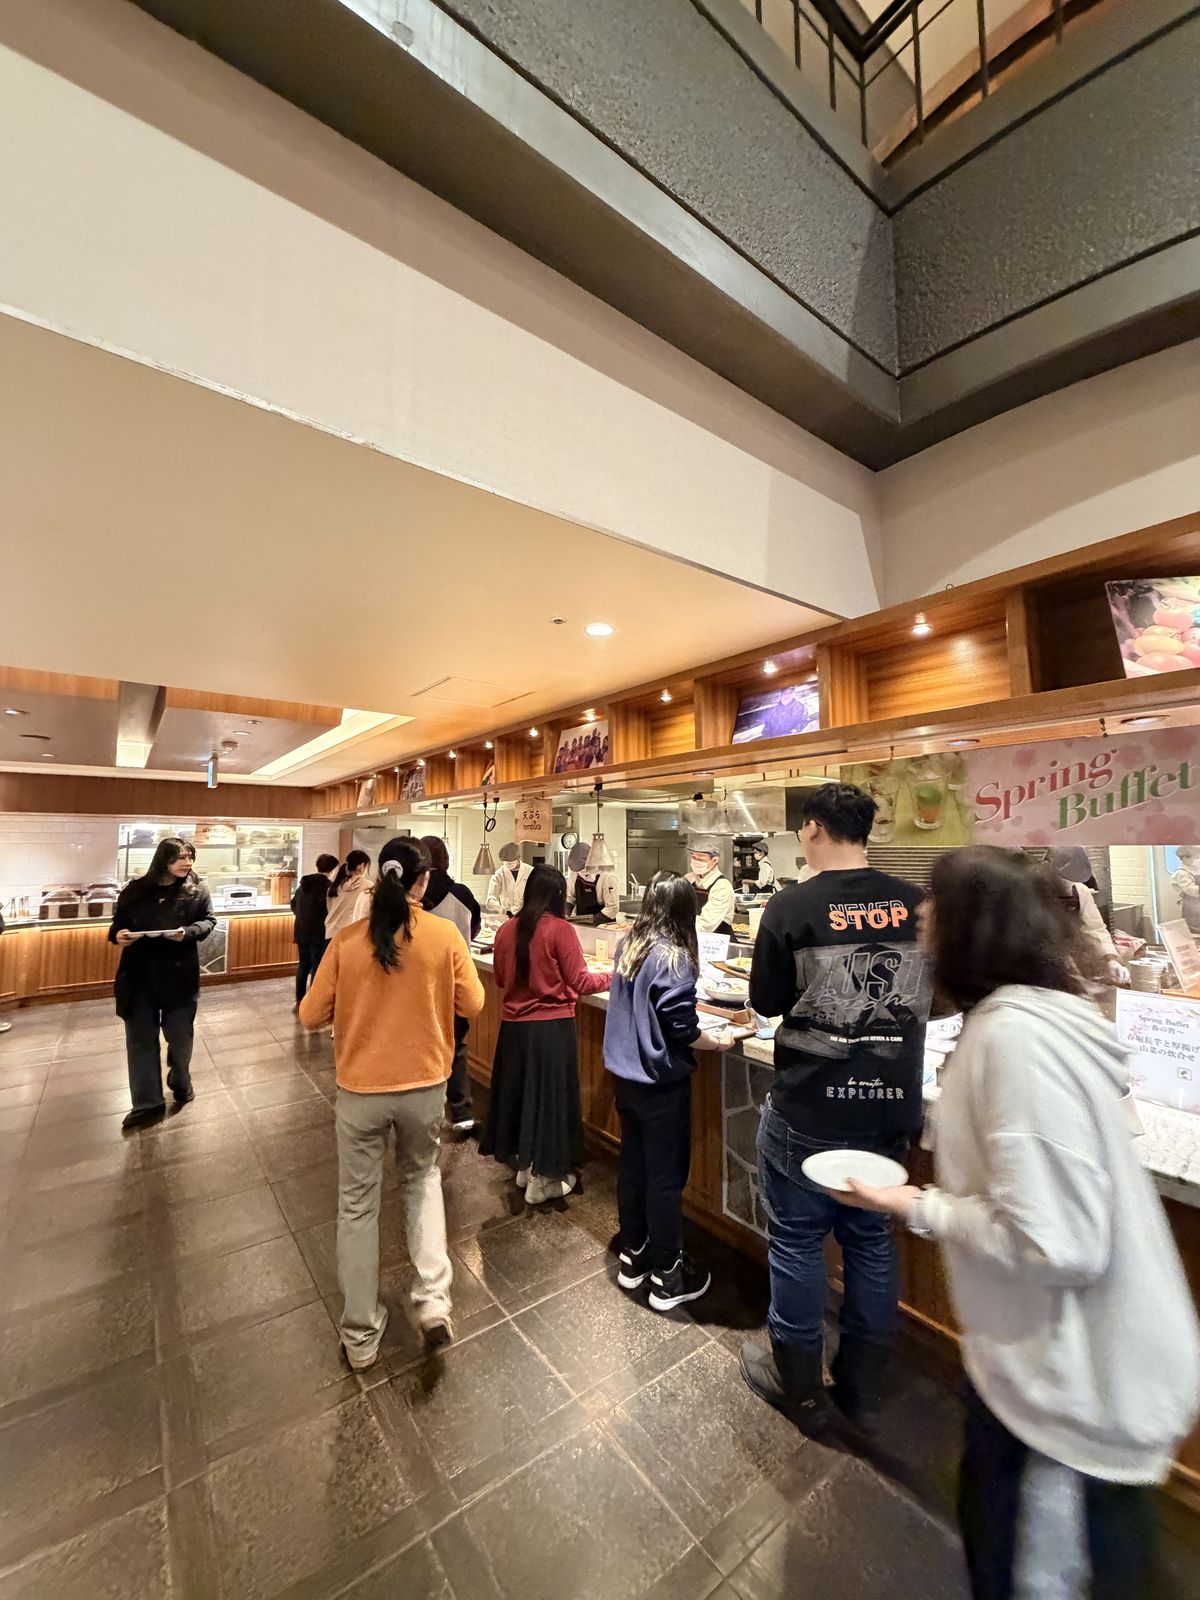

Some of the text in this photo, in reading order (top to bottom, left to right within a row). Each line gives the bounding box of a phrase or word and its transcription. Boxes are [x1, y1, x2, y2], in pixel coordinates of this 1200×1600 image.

[974, 749, 1119, 824] Spring
[1056, 760, 1195, 832] Buffet
[829, 906, 909, 931] STOP
[1138, 1015, 1163, 1025] Spring
[826, 1086, 905, 1100] EXPLORER
